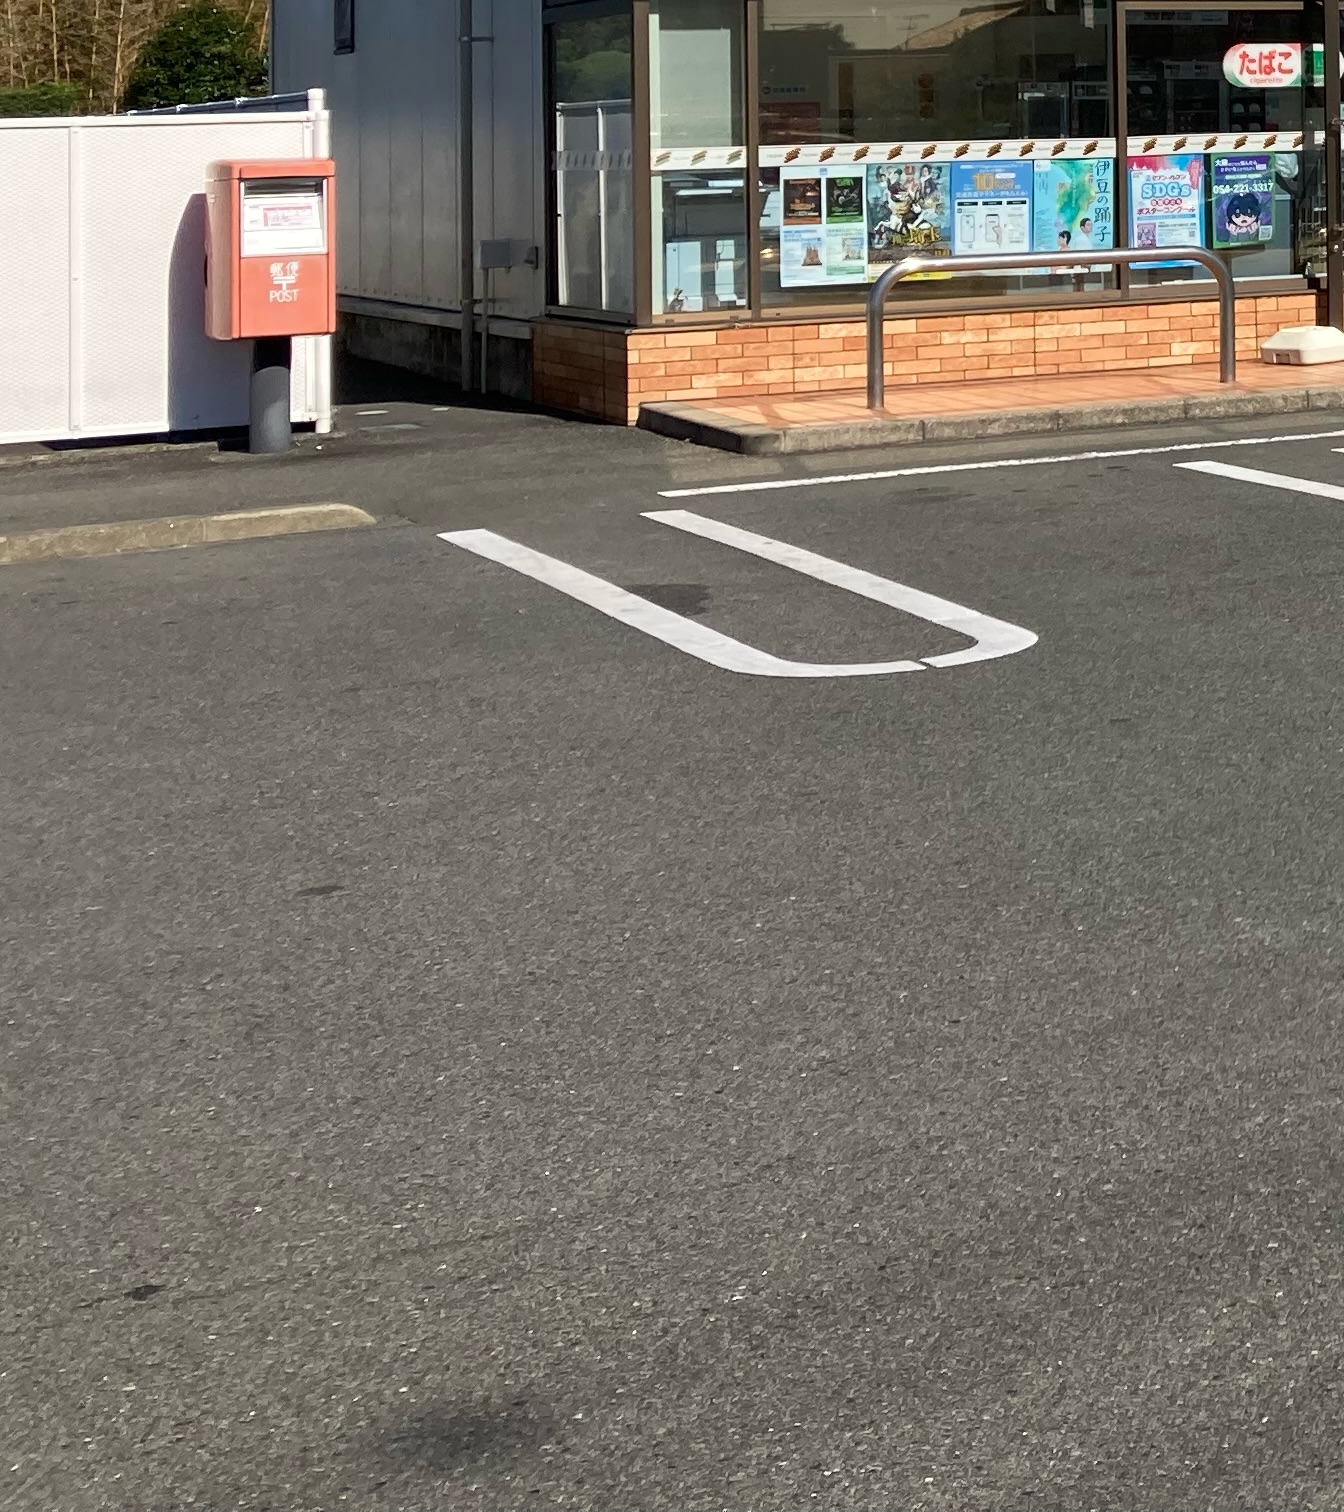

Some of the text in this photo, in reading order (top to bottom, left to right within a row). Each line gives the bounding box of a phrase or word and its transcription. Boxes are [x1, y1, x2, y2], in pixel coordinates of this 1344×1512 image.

[1239, 49, 1293, 76] たばこ
[1094, 160, 1111, 243] 伊豆の踊子
[1142, 182, 1191, 199] SDGs
[269, 289, 299, 303] POST
